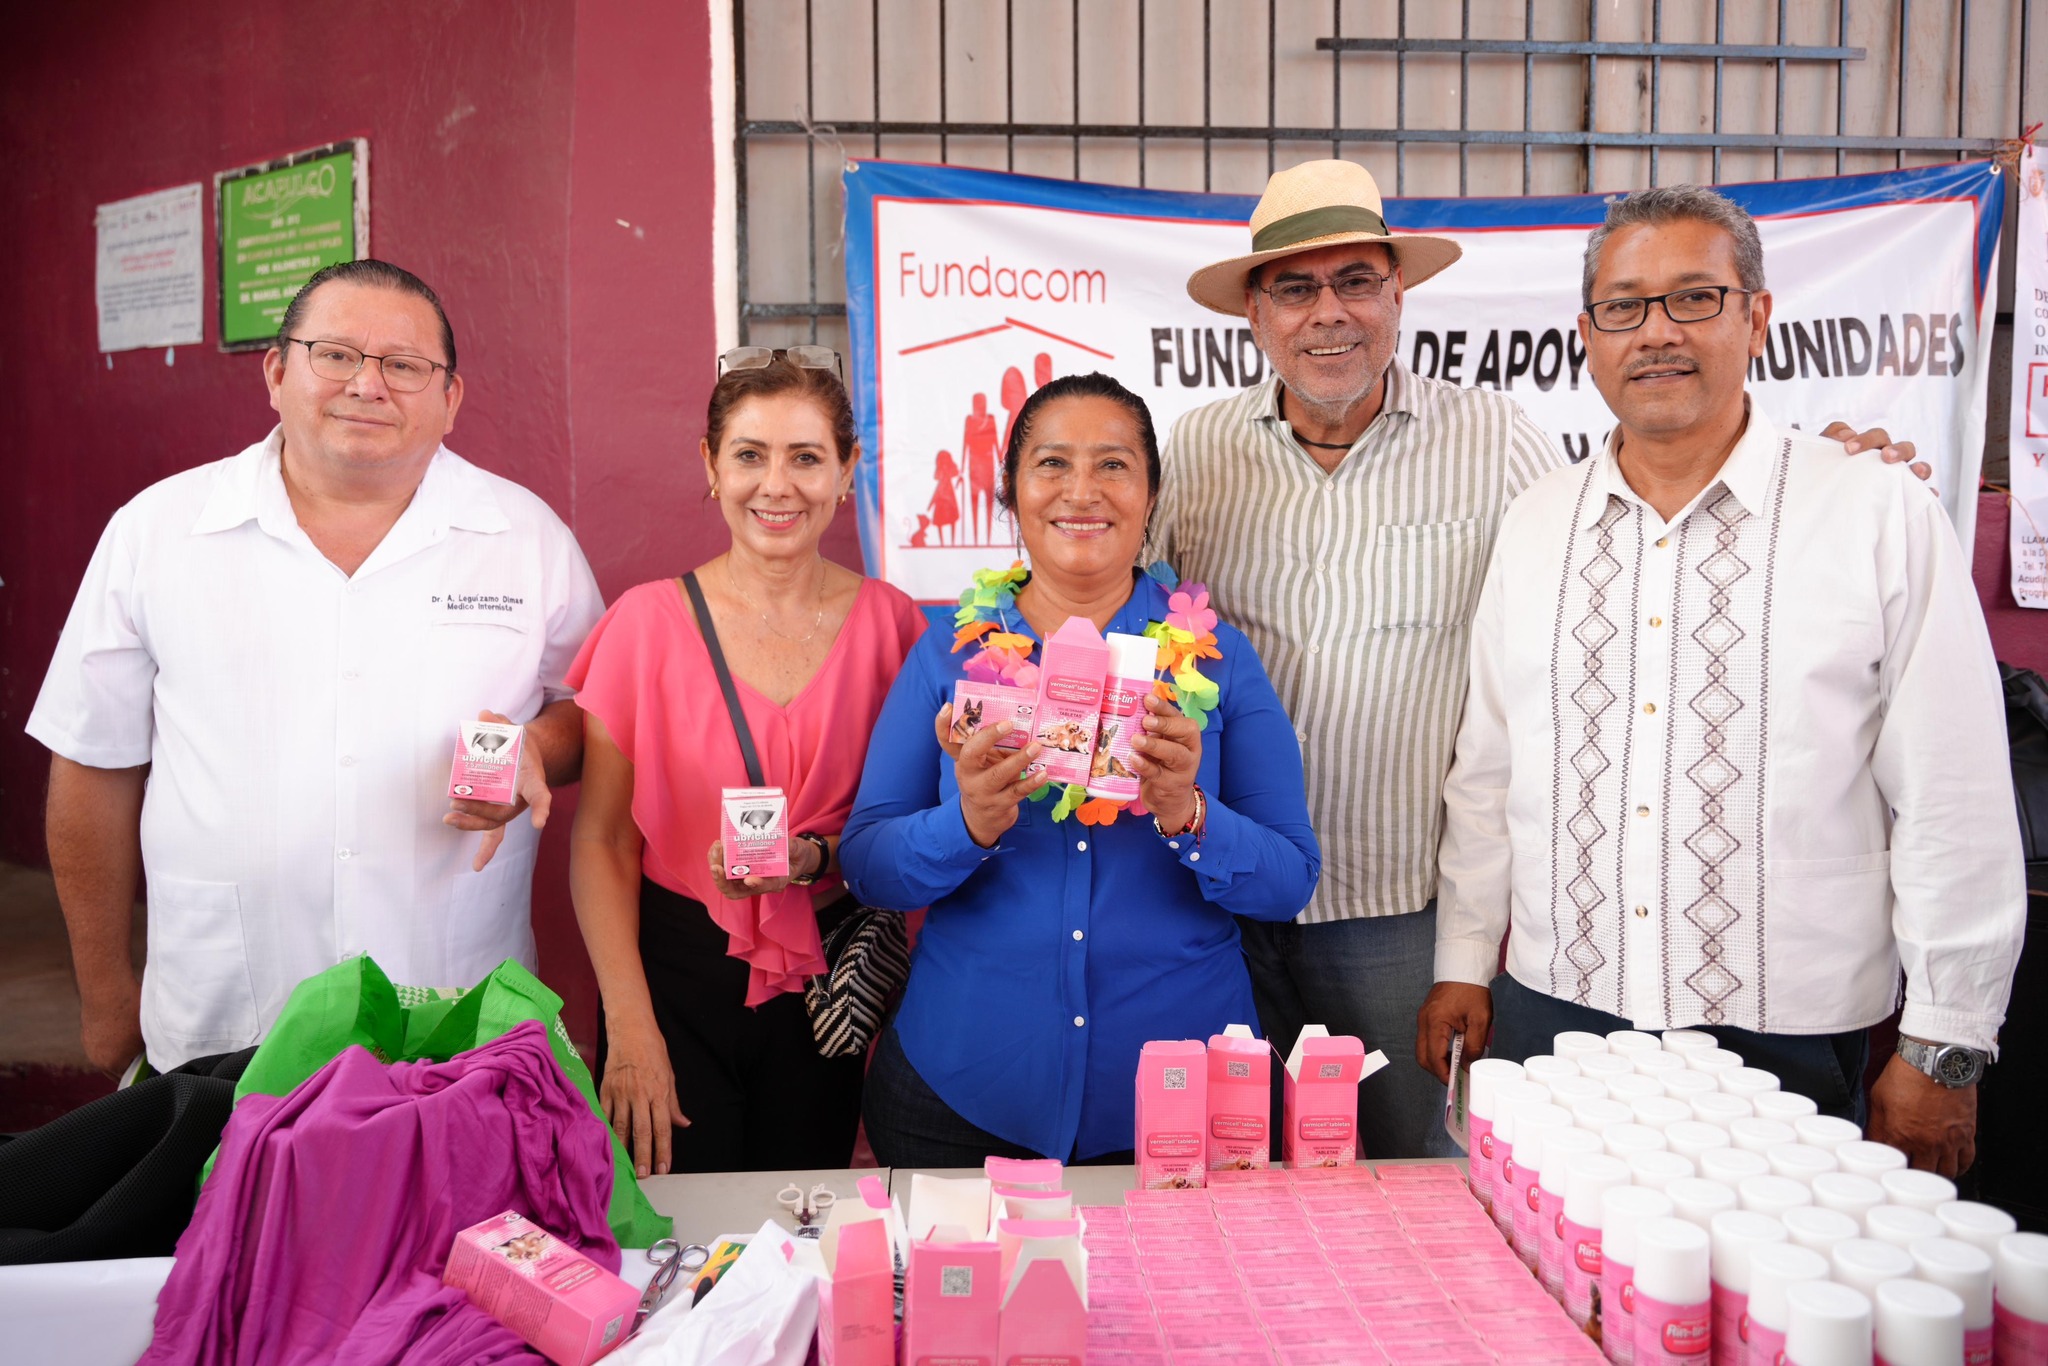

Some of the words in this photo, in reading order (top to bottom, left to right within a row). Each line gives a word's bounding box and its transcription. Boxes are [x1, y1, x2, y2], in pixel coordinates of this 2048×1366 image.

[242, 163, 336, 208] ACAPULCO
[900, 252, 1106, 303] Fundacom
[1412, 330, 1467, 386] DE
[1474, 328, 1592, 392] APOY
[1747, 312, 1965, 383] UNIDADES
[2033, 453, 2045, 467] Y
[447, 594, 455, 602] A.
[478, 603, 513, 612] Internista
[462, 754, 507, 765] ubricina
[734, 832, 778, 842] ubricina
[1578, 1243, 1601, 1258] Rin-
